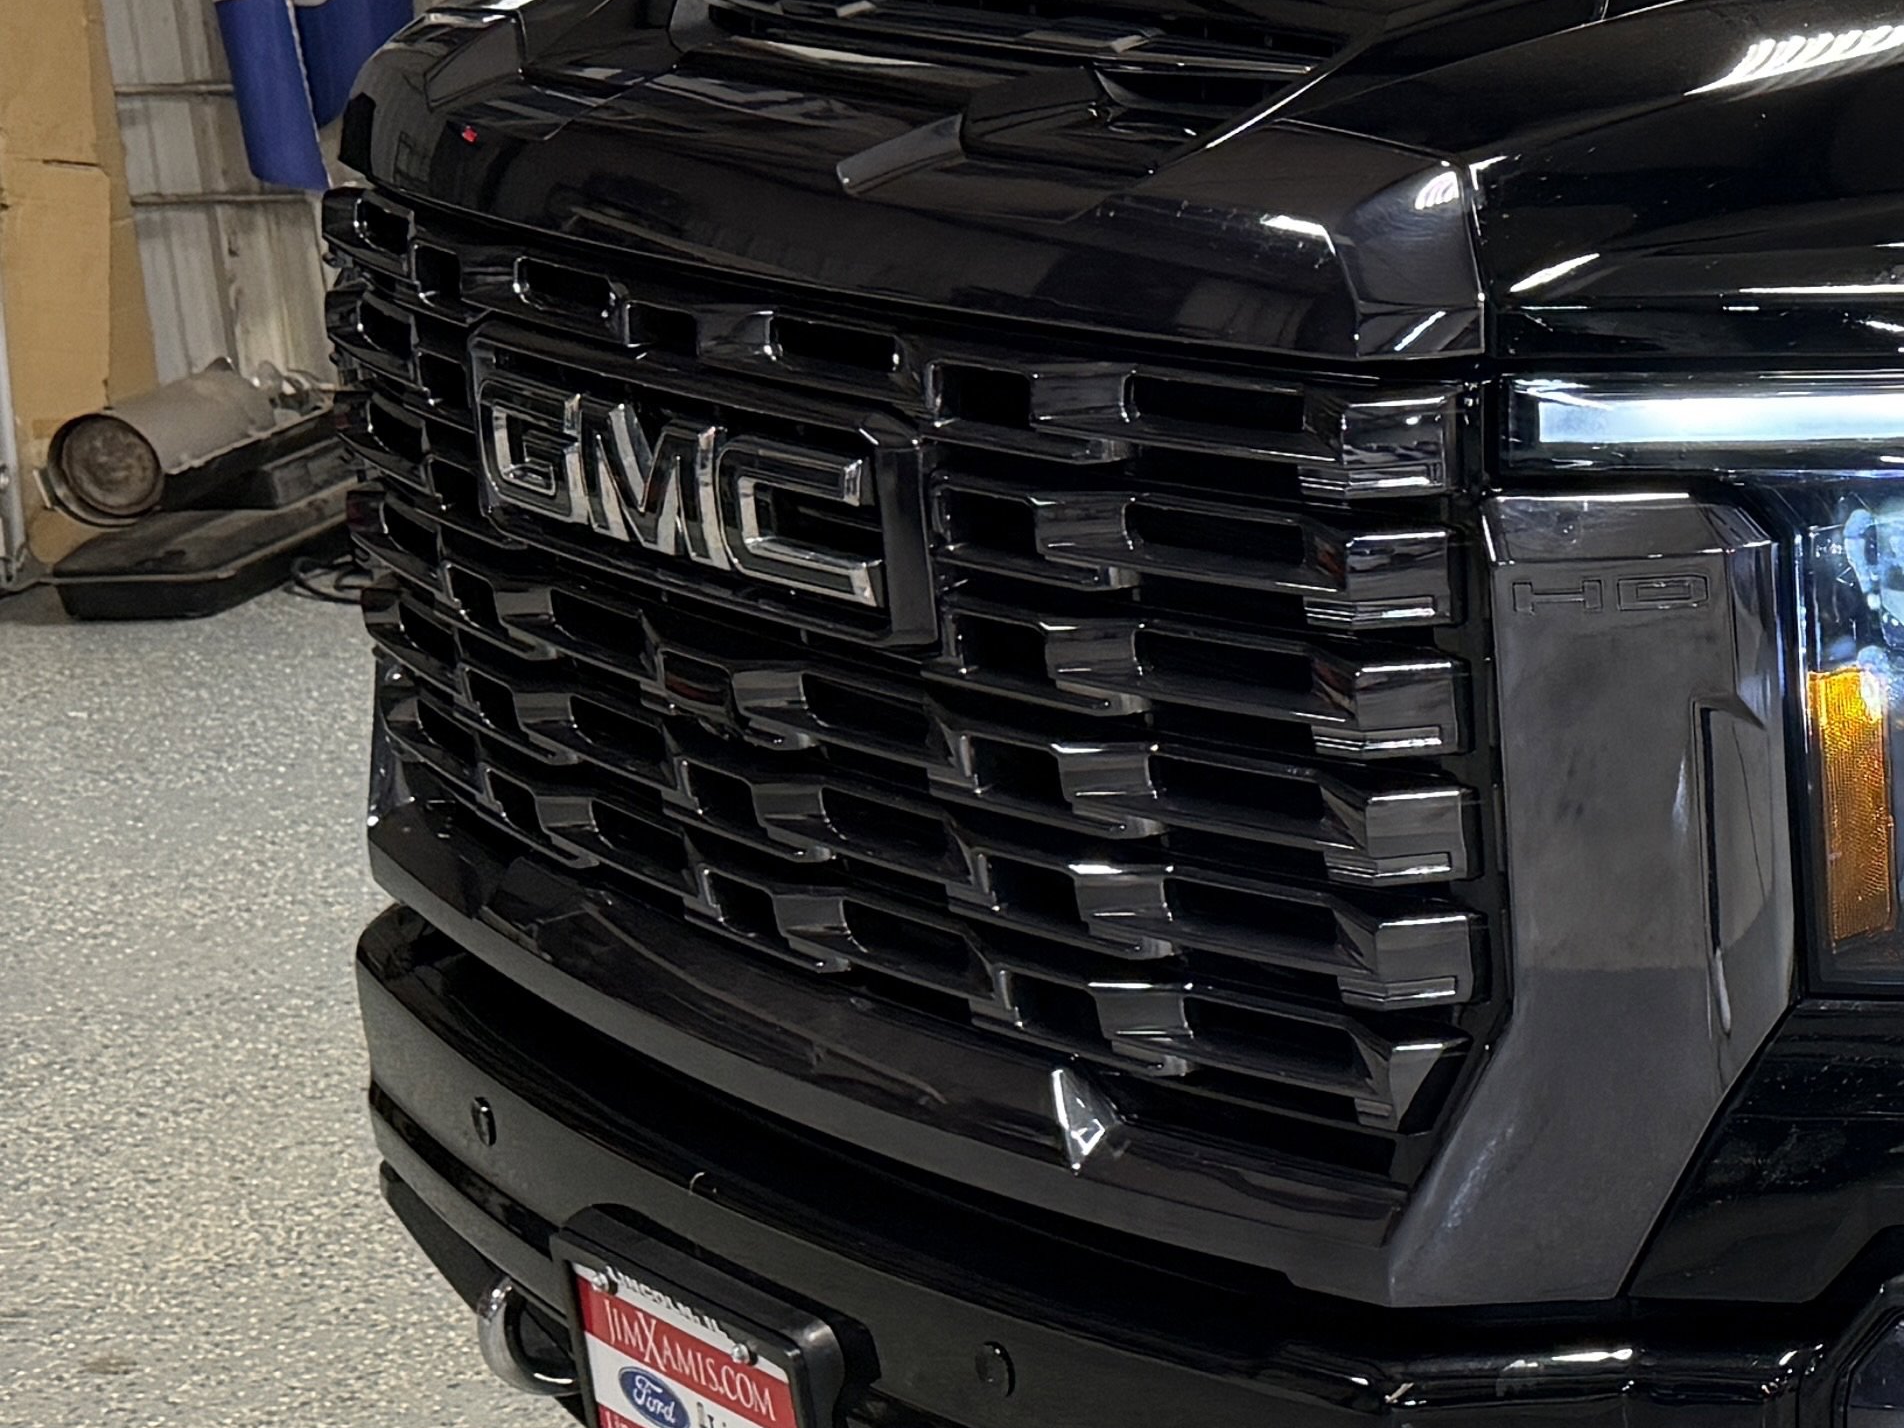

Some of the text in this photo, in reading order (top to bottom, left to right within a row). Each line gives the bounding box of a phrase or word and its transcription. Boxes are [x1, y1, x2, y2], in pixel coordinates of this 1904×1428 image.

[480, 380, 884, 608] GMC
[1511, 573, 1709, 615] HD
[605, 1299, 776, 1422] JIMXAMIS.COM
